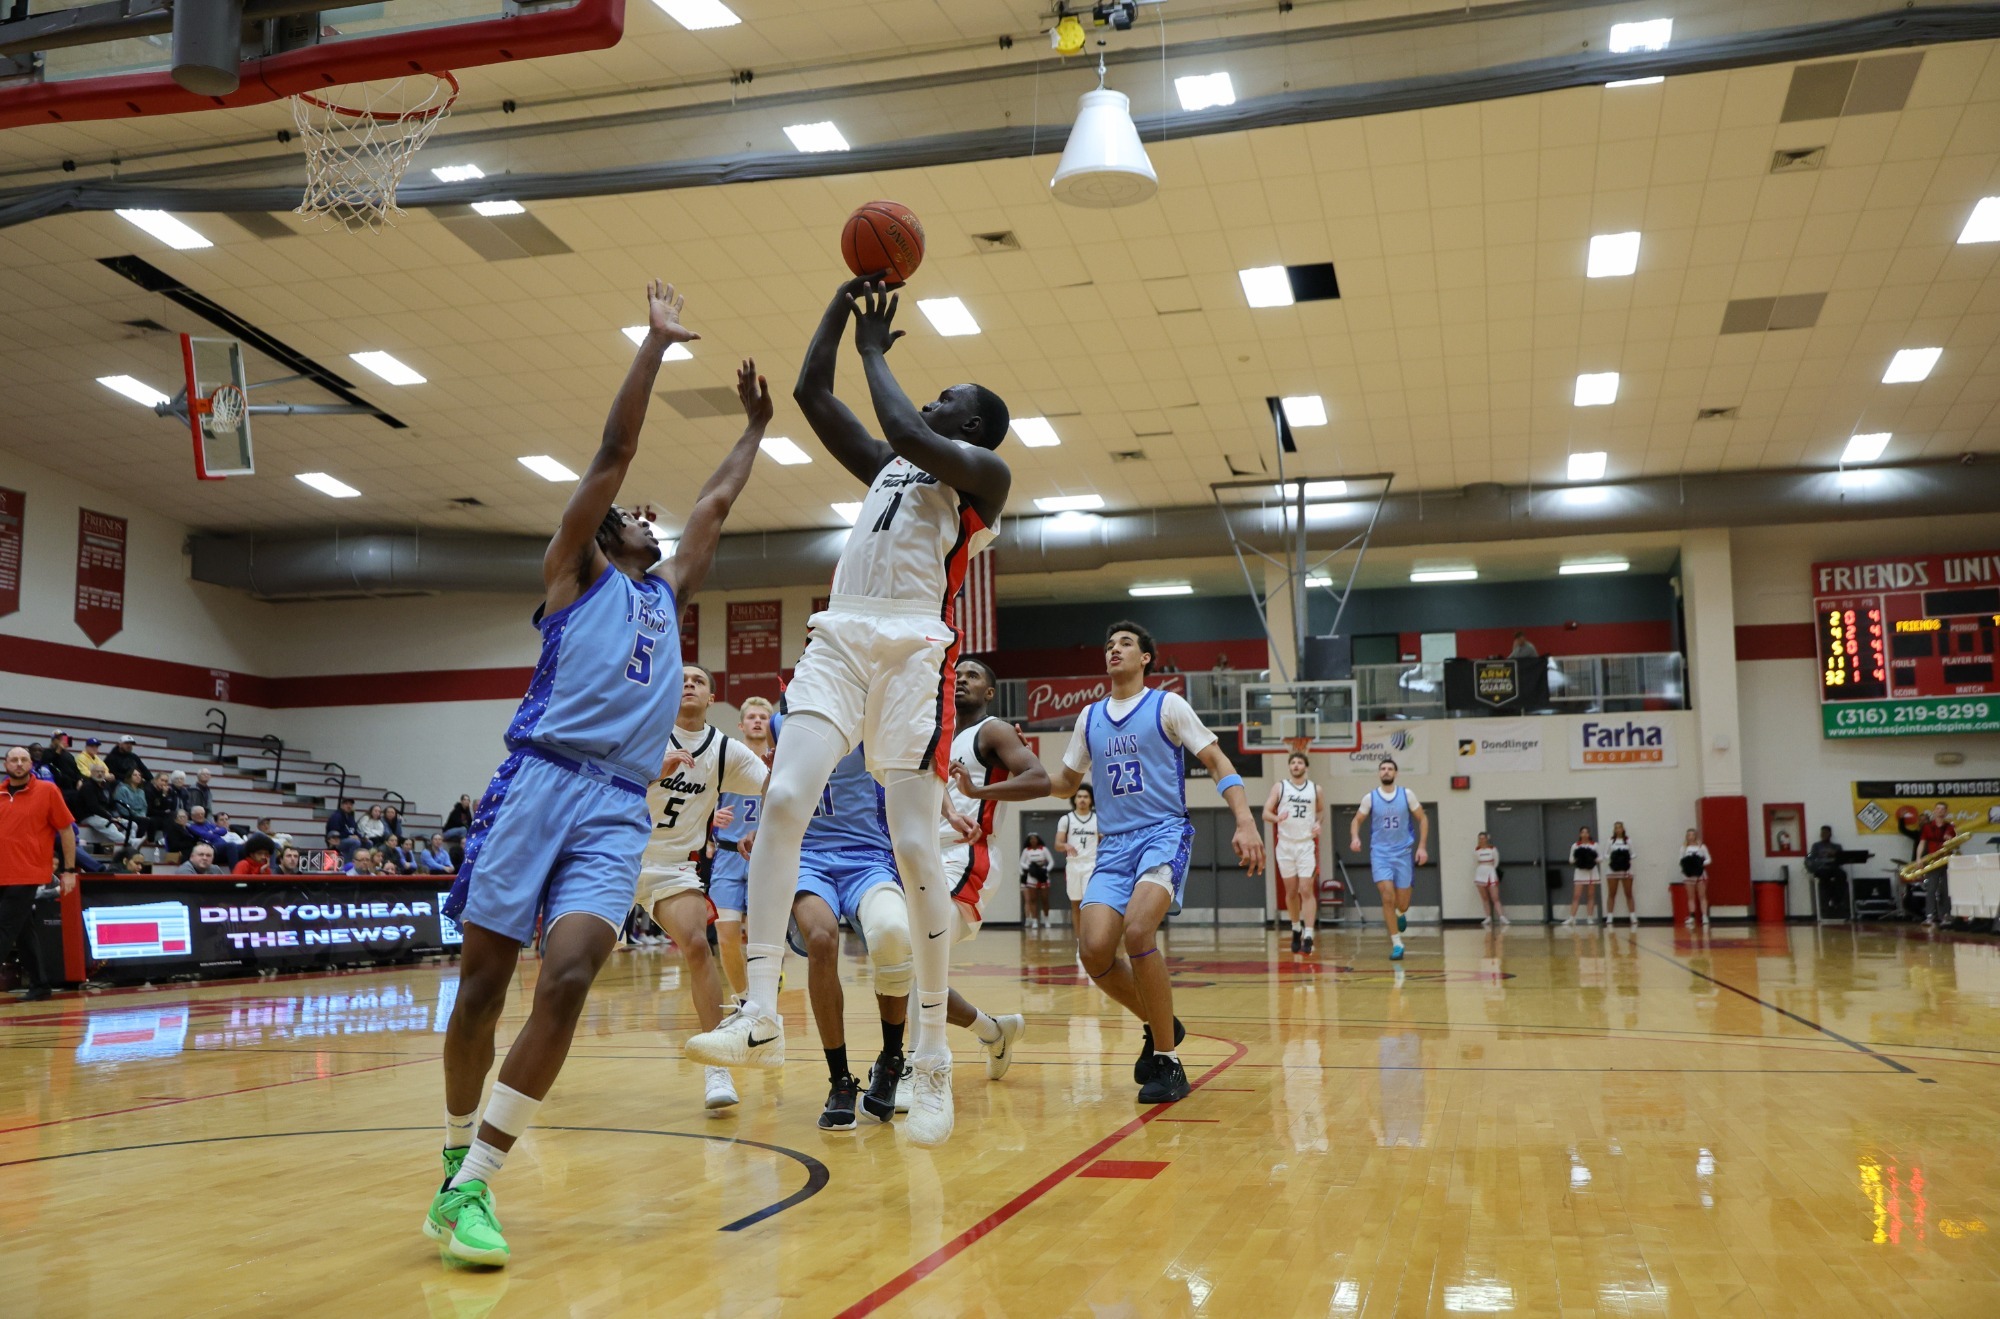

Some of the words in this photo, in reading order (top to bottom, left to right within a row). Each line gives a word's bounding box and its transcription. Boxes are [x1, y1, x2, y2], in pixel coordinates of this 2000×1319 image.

[871, 491, 903, 532] 11
[84, 511, 123, 531] FRIENDS
[1819, 561, 1929, 592] FRIENDS
[731, 604, 776, 616] FRIENDS
[1829, 610, 1841, 626] 2
[1844, 609, 1856, 625] 0
[1868, 609, 1880, 622] 4
[1830, 626, 1842, 639] 4
[1845, 624, 1857, 640] 2
[1869, 624, 1882, 637] 4
[1895, 618, 1941, 633] FRIENDS
[1831, 640, 1844, 656] 5
[1846, 639, 1858, 655] 0
[1870, 639, 1883, 652] 4
[624, 630, 656, 687] 5
[1827, 656, 1845, 669] 11
[1852, 655, 1859, 668] 1
[1891, 658, 1917, 668] FOULS
[1942, 656, 1972, 665] PLAYER
[1974, 654, 1994, 664] FOUL
[1480, 669, 1512, 679] ARMY
[1825, 669, 1846, 686] 32
[1853, 669, 1861, 683] 1
[1872, 668, 1885, 682] 4
[1480, 683, 1513, 694] GUARD
[1893, 688, 1919, 697] SCORE
[1955, 684, 1985, 694] MATCH
[1836, 707, 1888, 726] (316)
[1893, 702, 1989, 723] 219-8299
[1582, 721, 1662, 748] Farha
[1827, 720, 2000, 737] www.kansasjointandspine.com
[1104, 733, 1138, 759] JAYS
[1481, 739, 1539, 751] Dondlinger
[1348, 749, 1392, 762] Controls
[1585, 750, 1660, 763] ROOFING
[660, 771, 707, 795] alcons
[1106, 760, 1145, 798] 23
[1894, 783, 1935, 796] PROUD
[656, 797, 686, 828] 5
[743, 798, 760, 823] 2
[1292, 804, 1307, 819] 32
[1383, 816, 1399, 829] 35
[1080, 836, 1087, 849] 4
[200, 905, 267, 922] DID
[273, 904, 343, 920] YOU
[347, 902, 432, 919] HEAR
[227, 931, 300, 949] THE
[304, 924, 416, 945] NEWS?
